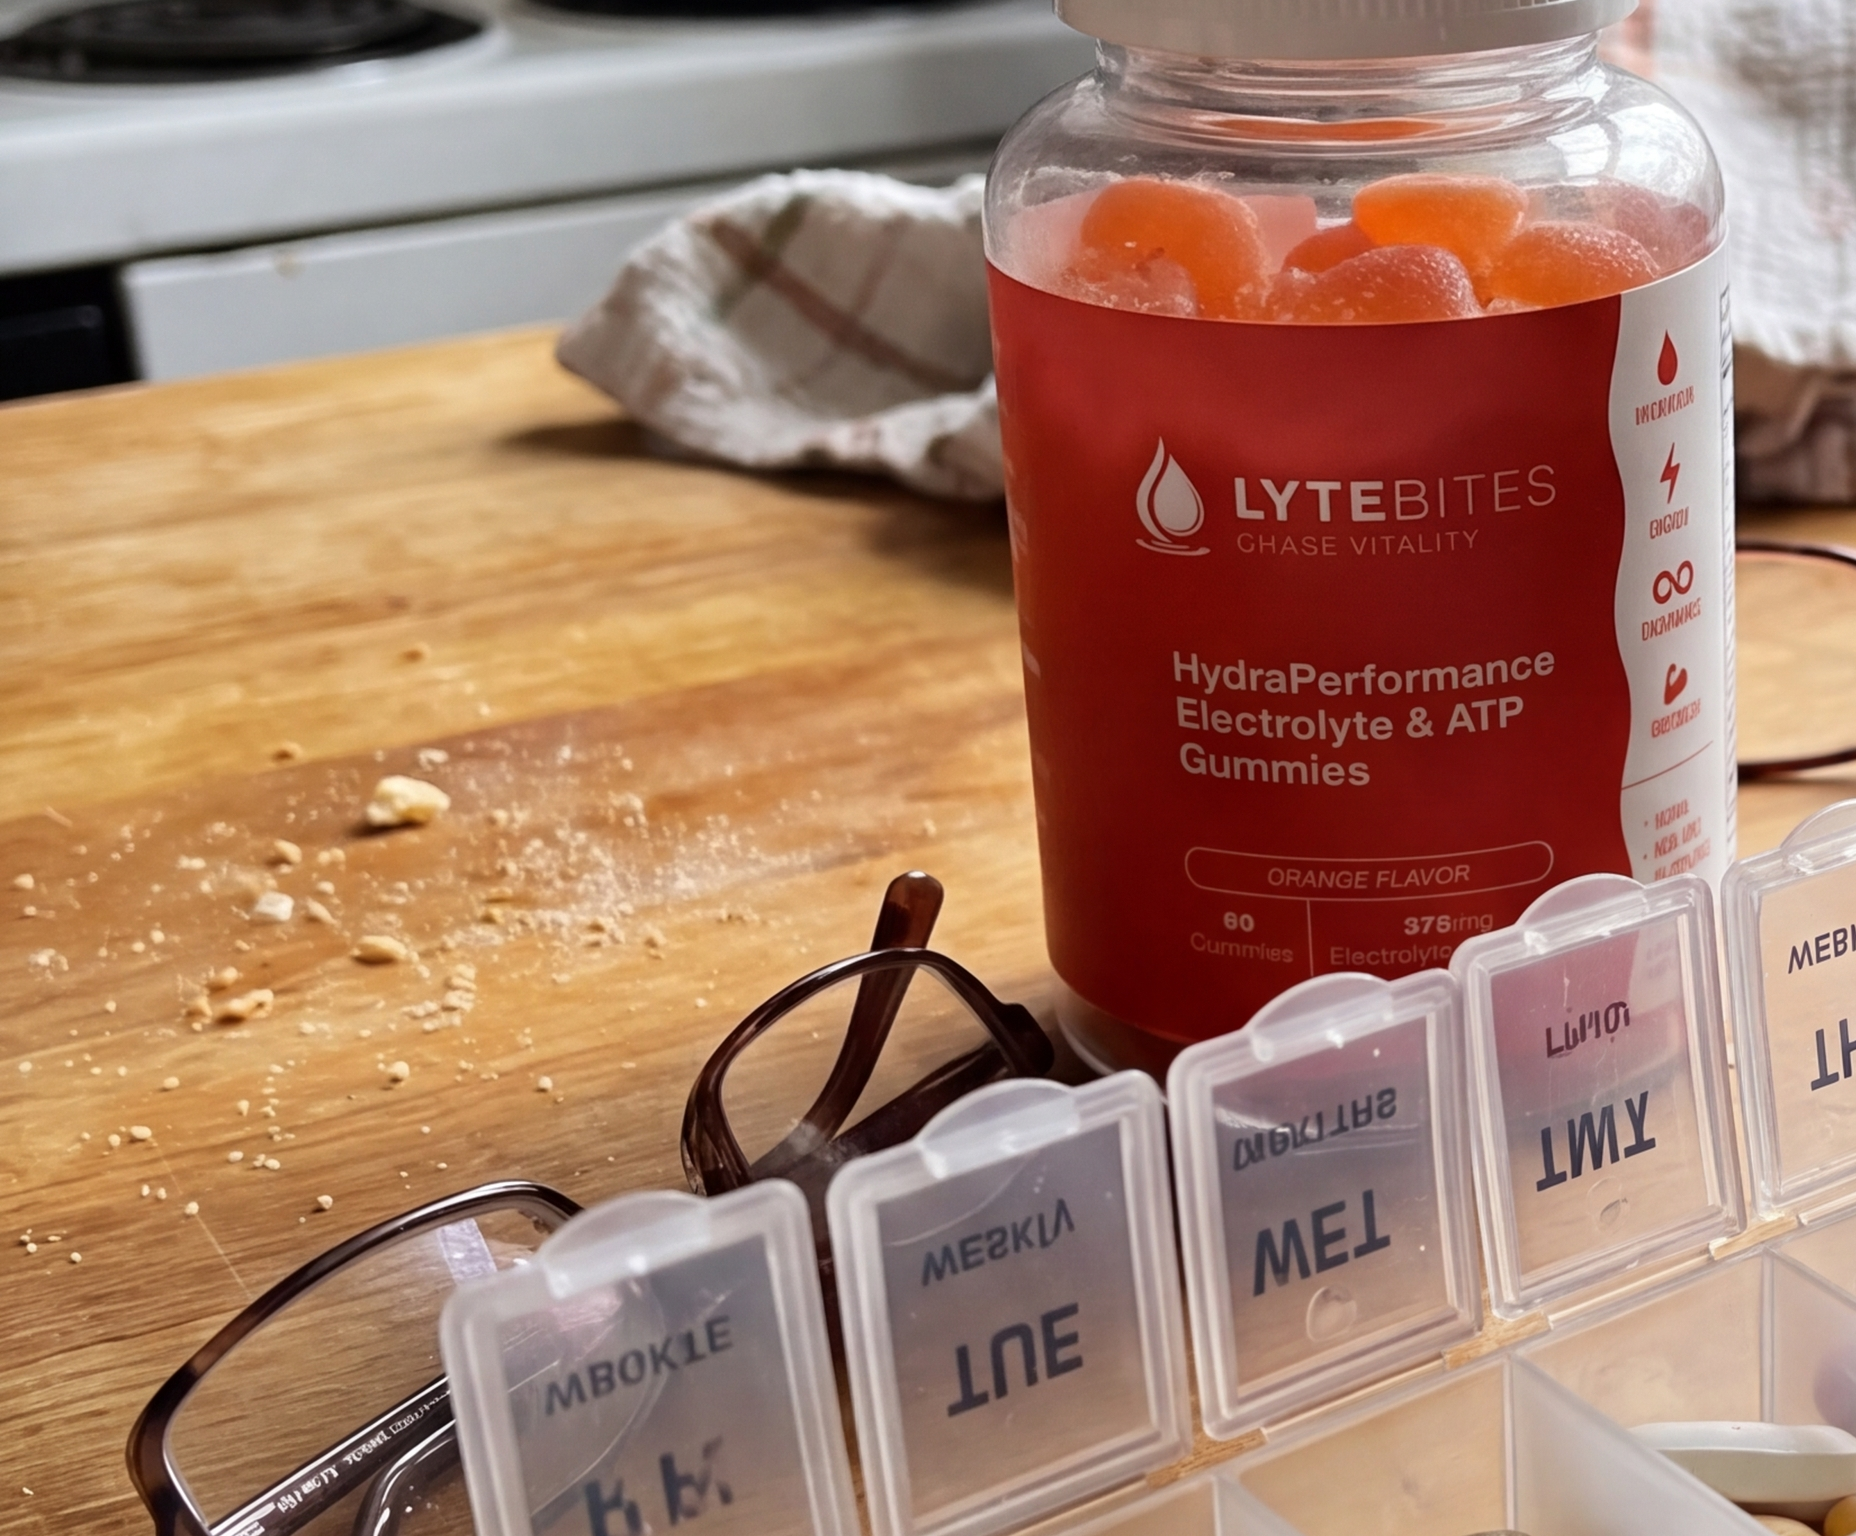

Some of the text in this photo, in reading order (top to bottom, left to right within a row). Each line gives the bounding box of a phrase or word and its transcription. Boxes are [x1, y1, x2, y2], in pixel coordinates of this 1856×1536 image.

[1234, 464, 1557, 522] LYTEBITES
[1350, 529, 1480, 556] VITALITY
[1173, 650, 1556, 696] HydraPerformance
[1176, 695, 1524, 748] Electrolyte & ATP
[1179, 742, 1371, 786] Gummies
[1267, 864, 1471, 889] ORANGE FLAVOR
